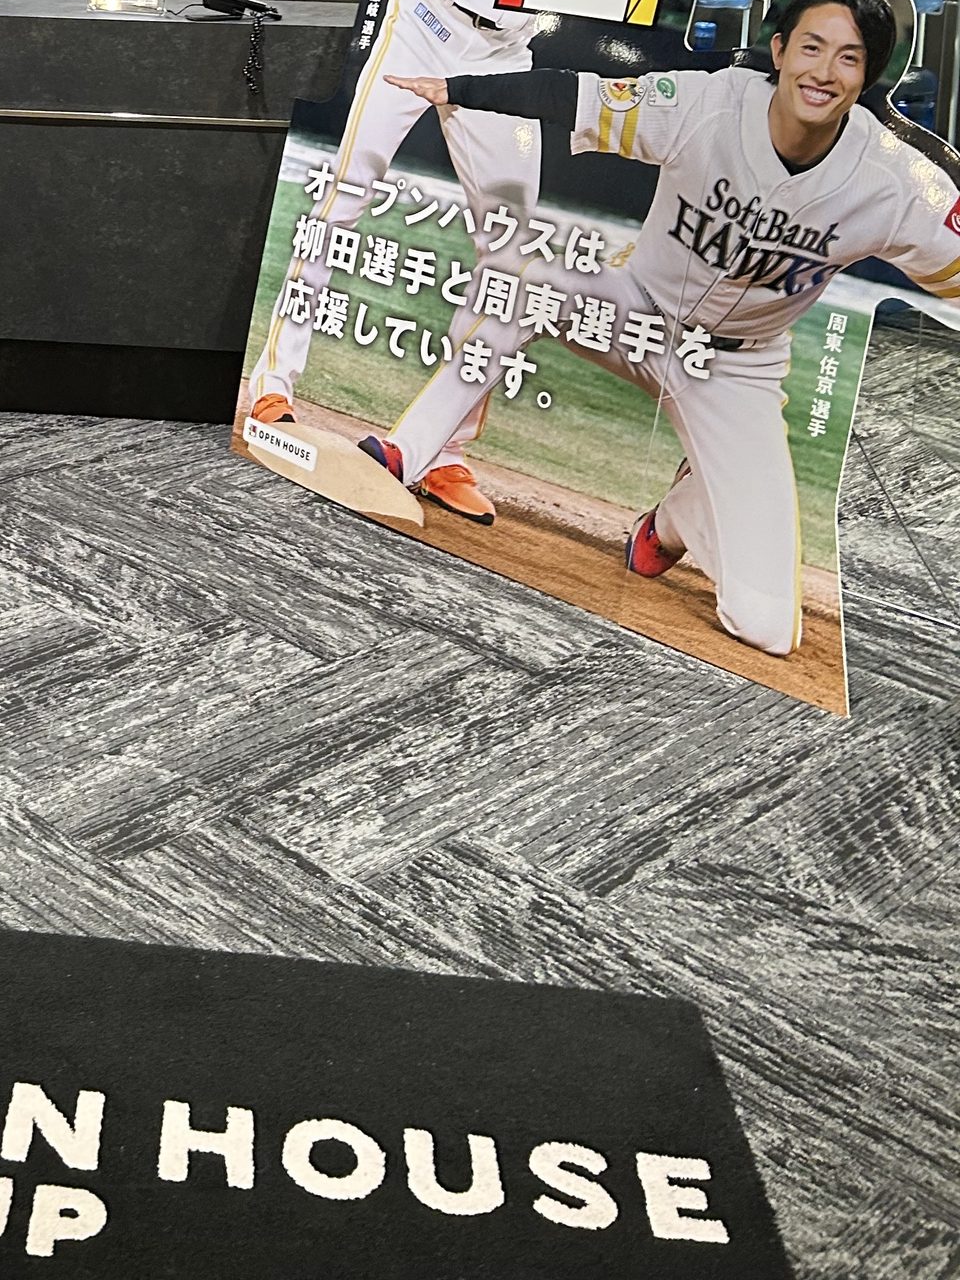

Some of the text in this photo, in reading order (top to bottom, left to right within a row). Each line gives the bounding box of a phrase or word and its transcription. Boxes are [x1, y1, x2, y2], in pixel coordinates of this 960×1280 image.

[304, 161, 607, 275] オープンハウスは
[706, 178, 841, 258] SoftBank
[278, 278, 553, 410] 応援しています。
[291, 213, 717, 381] 柳田選手と周東選手を
[807, 312, 848, 438] 周東佑京選手
[258, 430, 311, 461] OPEN HOUSE
[157, 1099, 730, 1244] HOUSE
